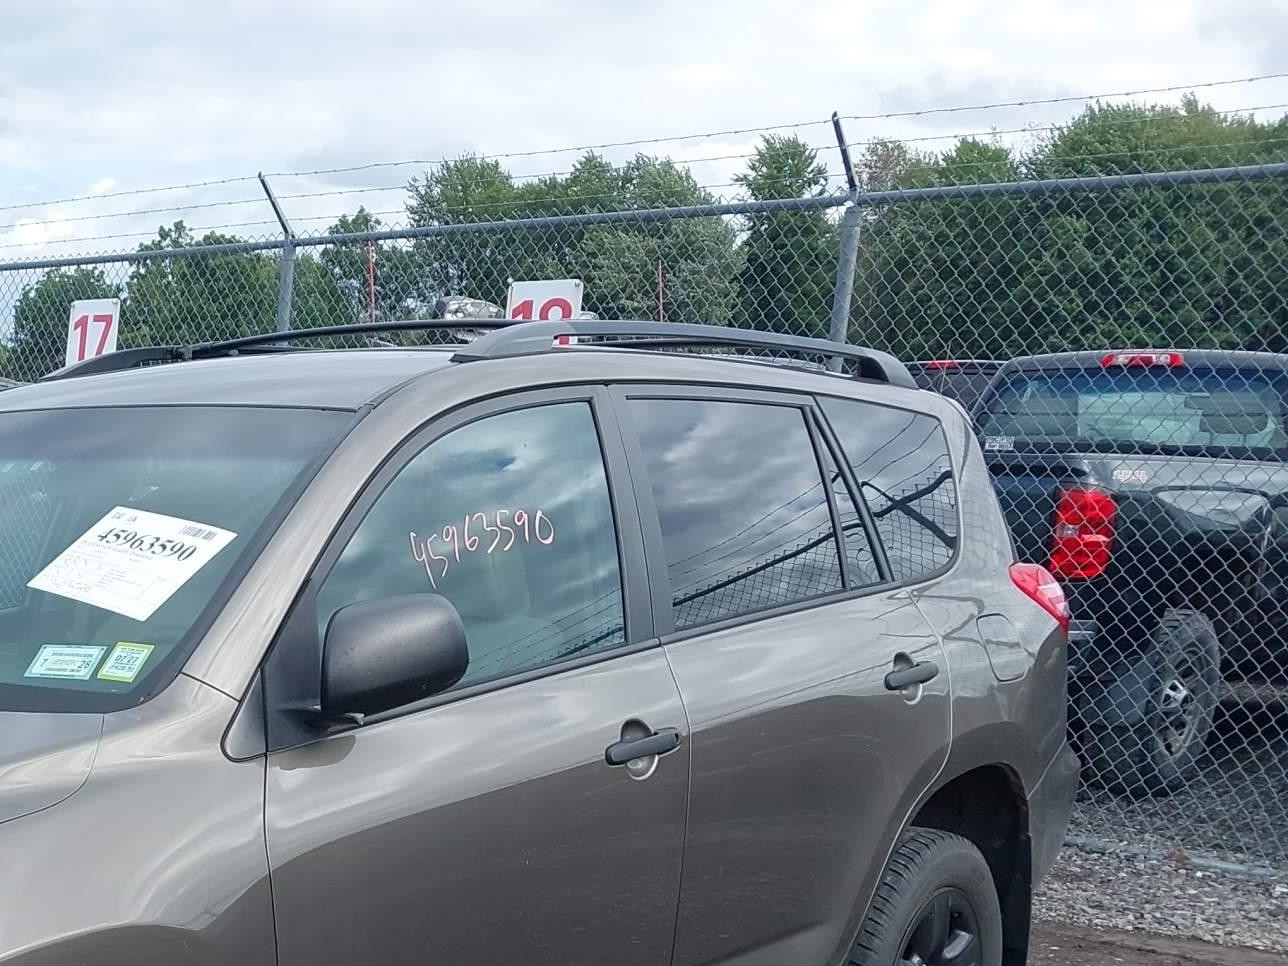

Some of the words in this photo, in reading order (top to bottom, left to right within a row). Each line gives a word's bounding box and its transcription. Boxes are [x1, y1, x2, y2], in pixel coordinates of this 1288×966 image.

[73, 314, 114, 362] 17
[97, 527, 198, 562] 45963590
[409, 509, 554, 590] 45963590
